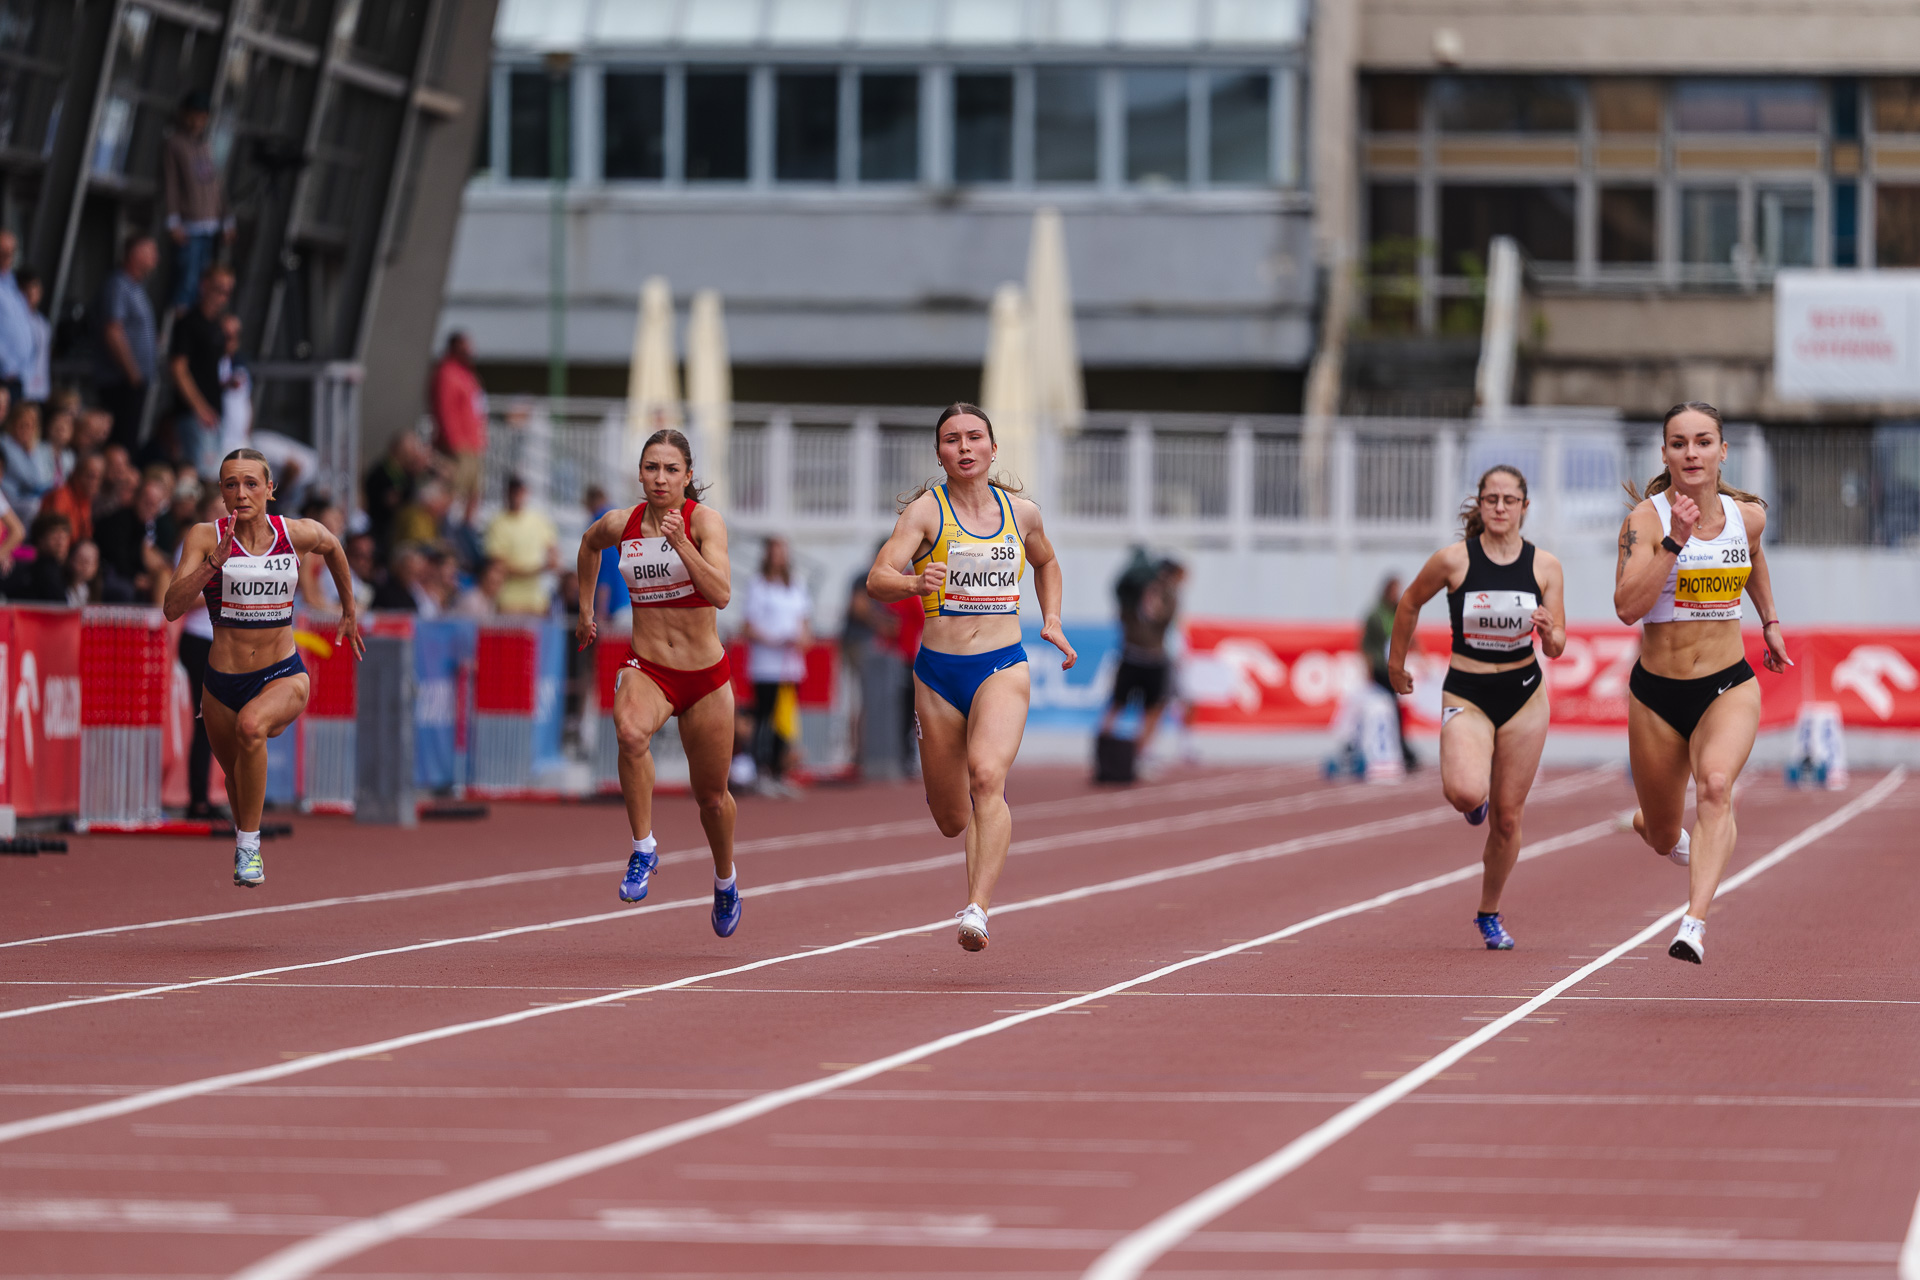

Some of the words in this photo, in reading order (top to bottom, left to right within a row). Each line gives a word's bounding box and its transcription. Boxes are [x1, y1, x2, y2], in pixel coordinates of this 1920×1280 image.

[991, 546, 1015, 560] 358
[1722, 548, 1747, 563] 288
[264, 557, 291, 571] 419
[633, 562, 672, 580] BIBIK
[949, 570, 1015, 587] KANICKA
[230, 581, 289, 596] KUDZIA
[638, 592, 664, 601] KRAKÓW
[665, 590, 681, 598] 2025
[958, 603, 992, 611] KRAKÓW
[1515, 595, 1522, 607] 1
[1479, 617, 1522, 629] BLUM
